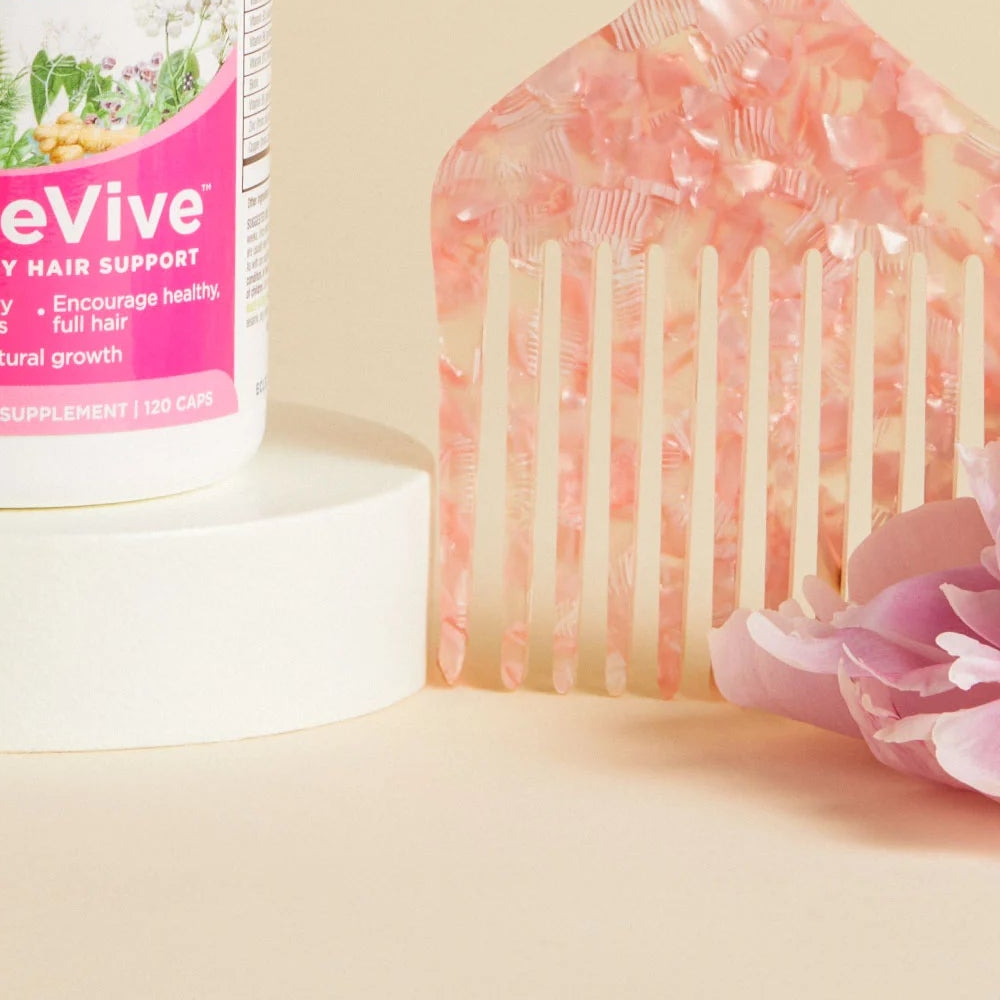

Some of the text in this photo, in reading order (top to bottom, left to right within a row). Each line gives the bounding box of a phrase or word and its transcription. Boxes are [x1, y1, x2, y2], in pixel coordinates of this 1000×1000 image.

[27, 258, 90, 277] HAIR
[99, 247, 199, 275] SUPPORT
[53, 292, 158, 313] Encourage
[162, 281, 221, 305] healthy,
[52, 313, 129, 334] full hair
[51, 344, 123, 369] growth
[0, 401, 129, 423] SUPPLEMENT
[143, 397, 172, 415] 120
[175, 390, 214, 412] CAPS
